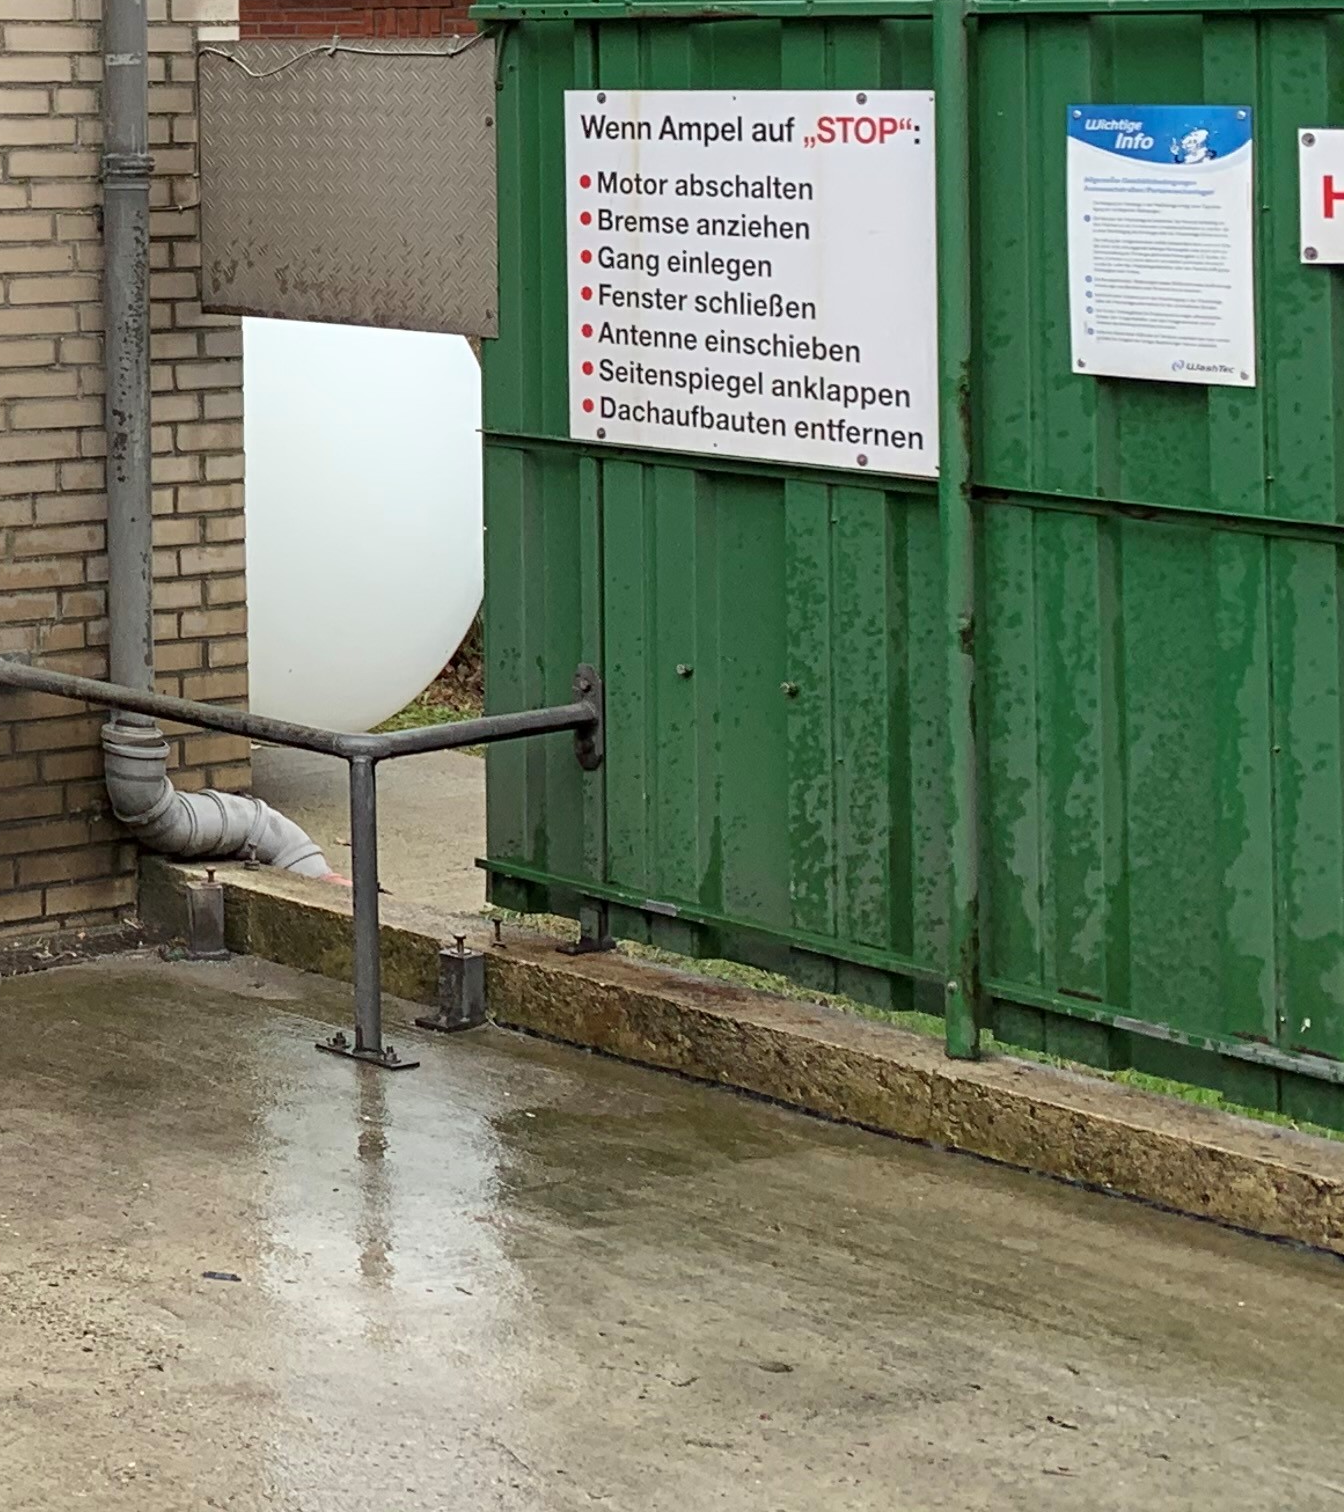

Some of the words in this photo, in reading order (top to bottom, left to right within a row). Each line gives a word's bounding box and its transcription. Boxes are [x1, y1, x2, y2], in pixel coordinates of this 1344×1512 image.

[580, 114, 652, 140] Wenn
[658, 115, 744, 147] Ampel
[751, 117, 795, 142] auf
[803, 116, 921, 148] „STOP“:
[1085, 119, 1143, 133] Wichtige
[1115, 133, 1154, 150] Info
[597, 172, 668, 196] Motor
[675, 175, 814, 201] abschalten
[597, 210, 689, 234] Bremse
[696, 215, 811, 240] anziehen
[597, 246, 660, 276] Gang
[667, 252, 772, 281] einlegen
[598, 284, 688, 311] Fenster
[695, 291, 817, 320] schließen
[598, 322, 698, 350] Antenne
[705, 330, 861, 363] einschieben
[599, 360, 763, 397] Seitenspiegel
[771, 375, 911, 409] anklappen
[600, 397, 786, 437] Dachaufbauten
[794, 420, 924, 450] entfernen
